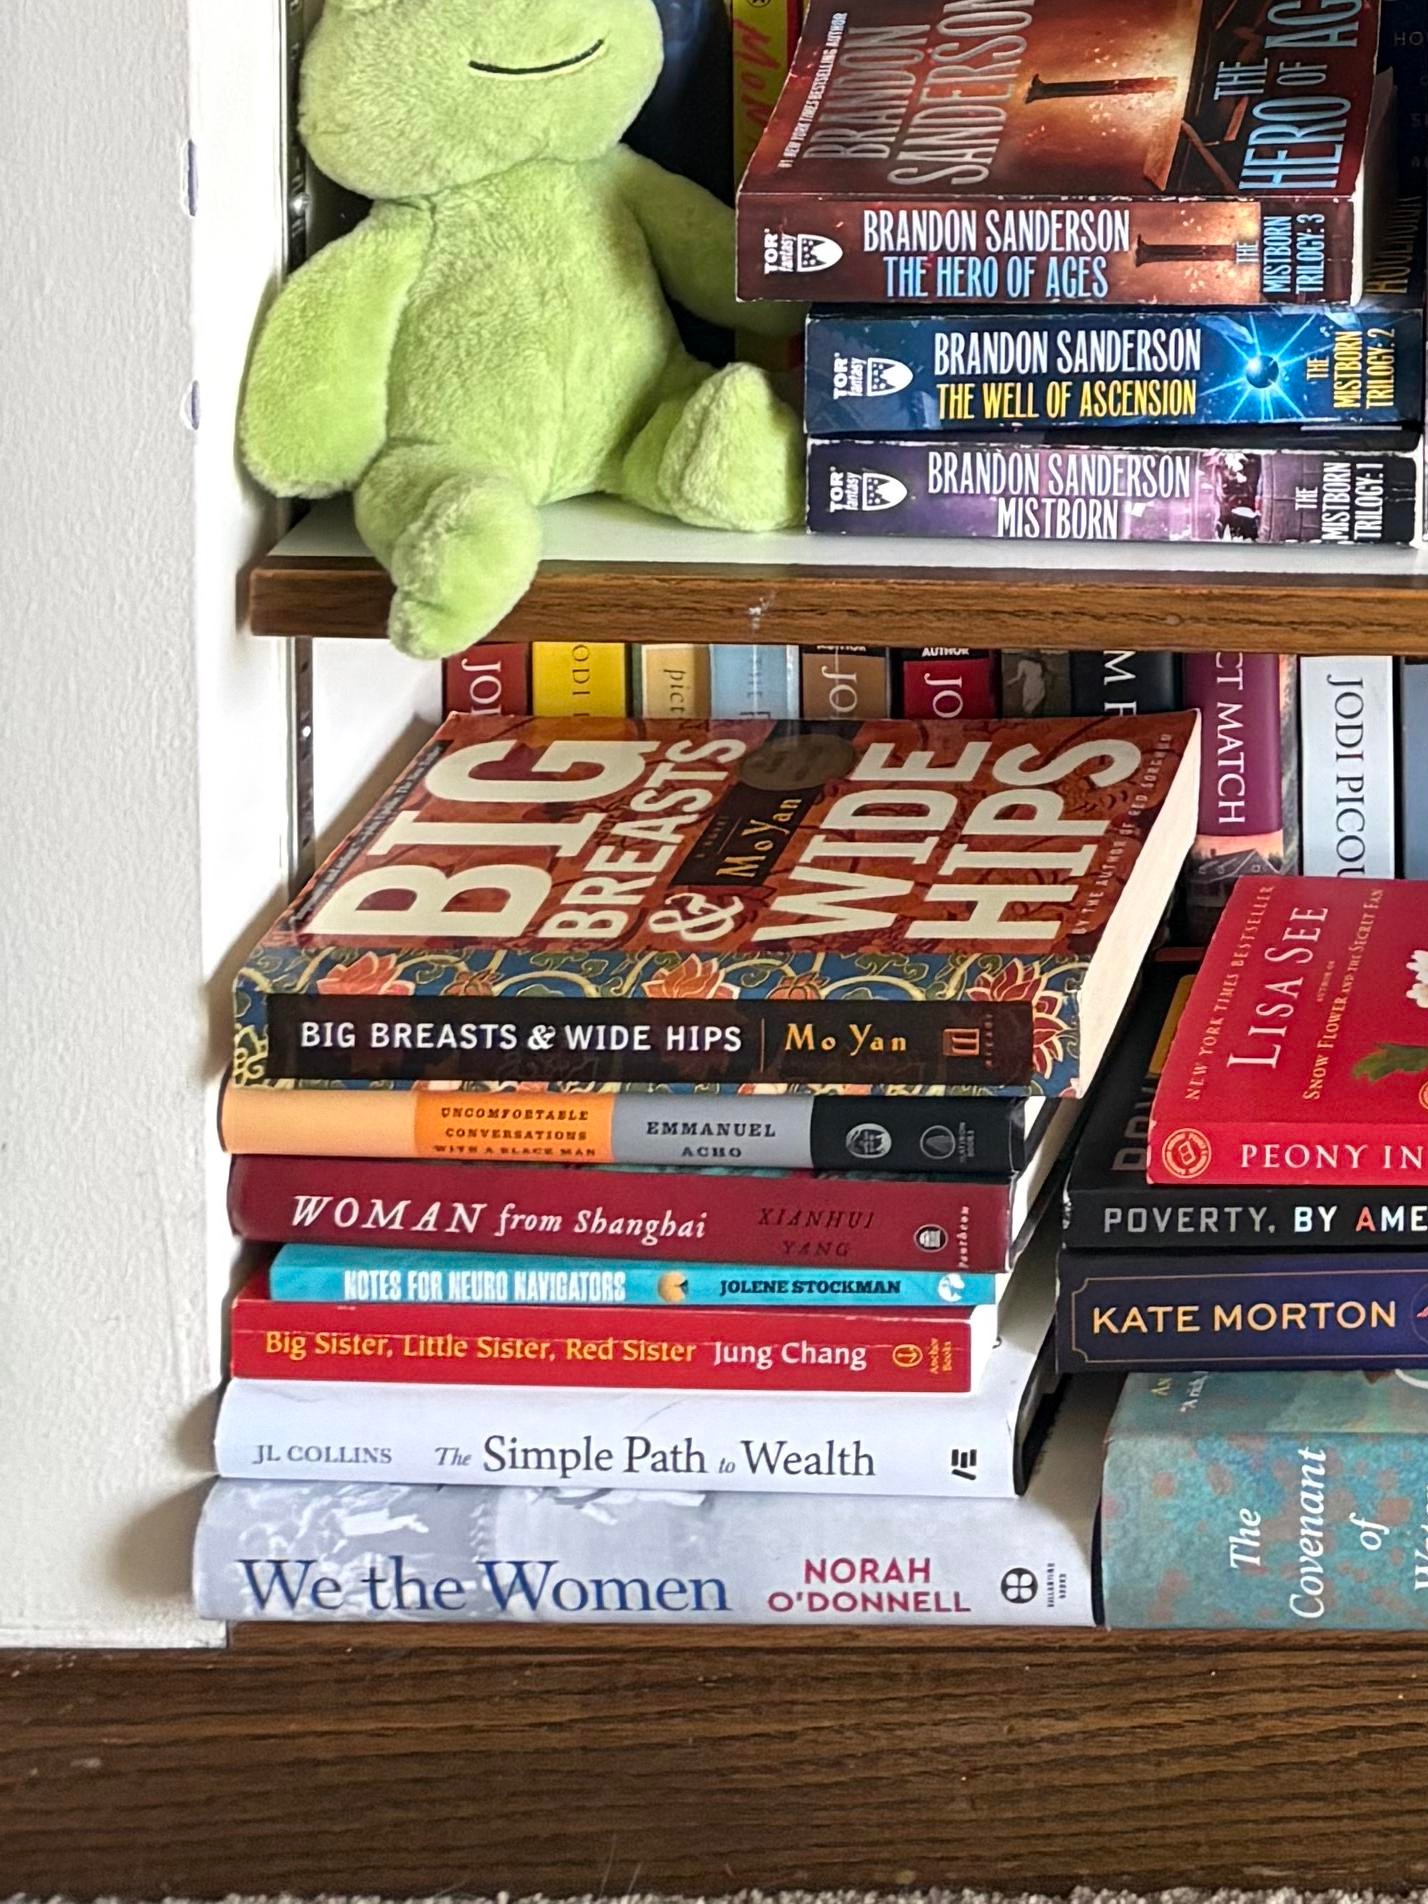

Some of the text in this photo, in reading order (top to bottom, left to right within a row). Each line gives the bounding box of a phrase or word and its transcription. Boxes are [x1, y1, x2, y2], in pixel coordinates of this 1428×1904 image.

[863, 209, 1130, 253] BRANDON SANDERSON
[301, 1021, 743, 1053] BIG BREASTS & WIDE HIPS
[1241, 1142, 1372, 1171] PEONY
[1092, 1304, 1200, 1335] KATE
[1212, 1300, 1397, 1331] MORTON
[265, 1330, 696, 1364] Big Sister, Little Sister, Red Sister
[435, 1435, 876, 1479] The Simple Path to Wealth
[237, 1557, 733, 1615] We the Women
[803, 1558, 931, 1585] NORAH
[768, 1589, 972, 1615] O'DONNELL
